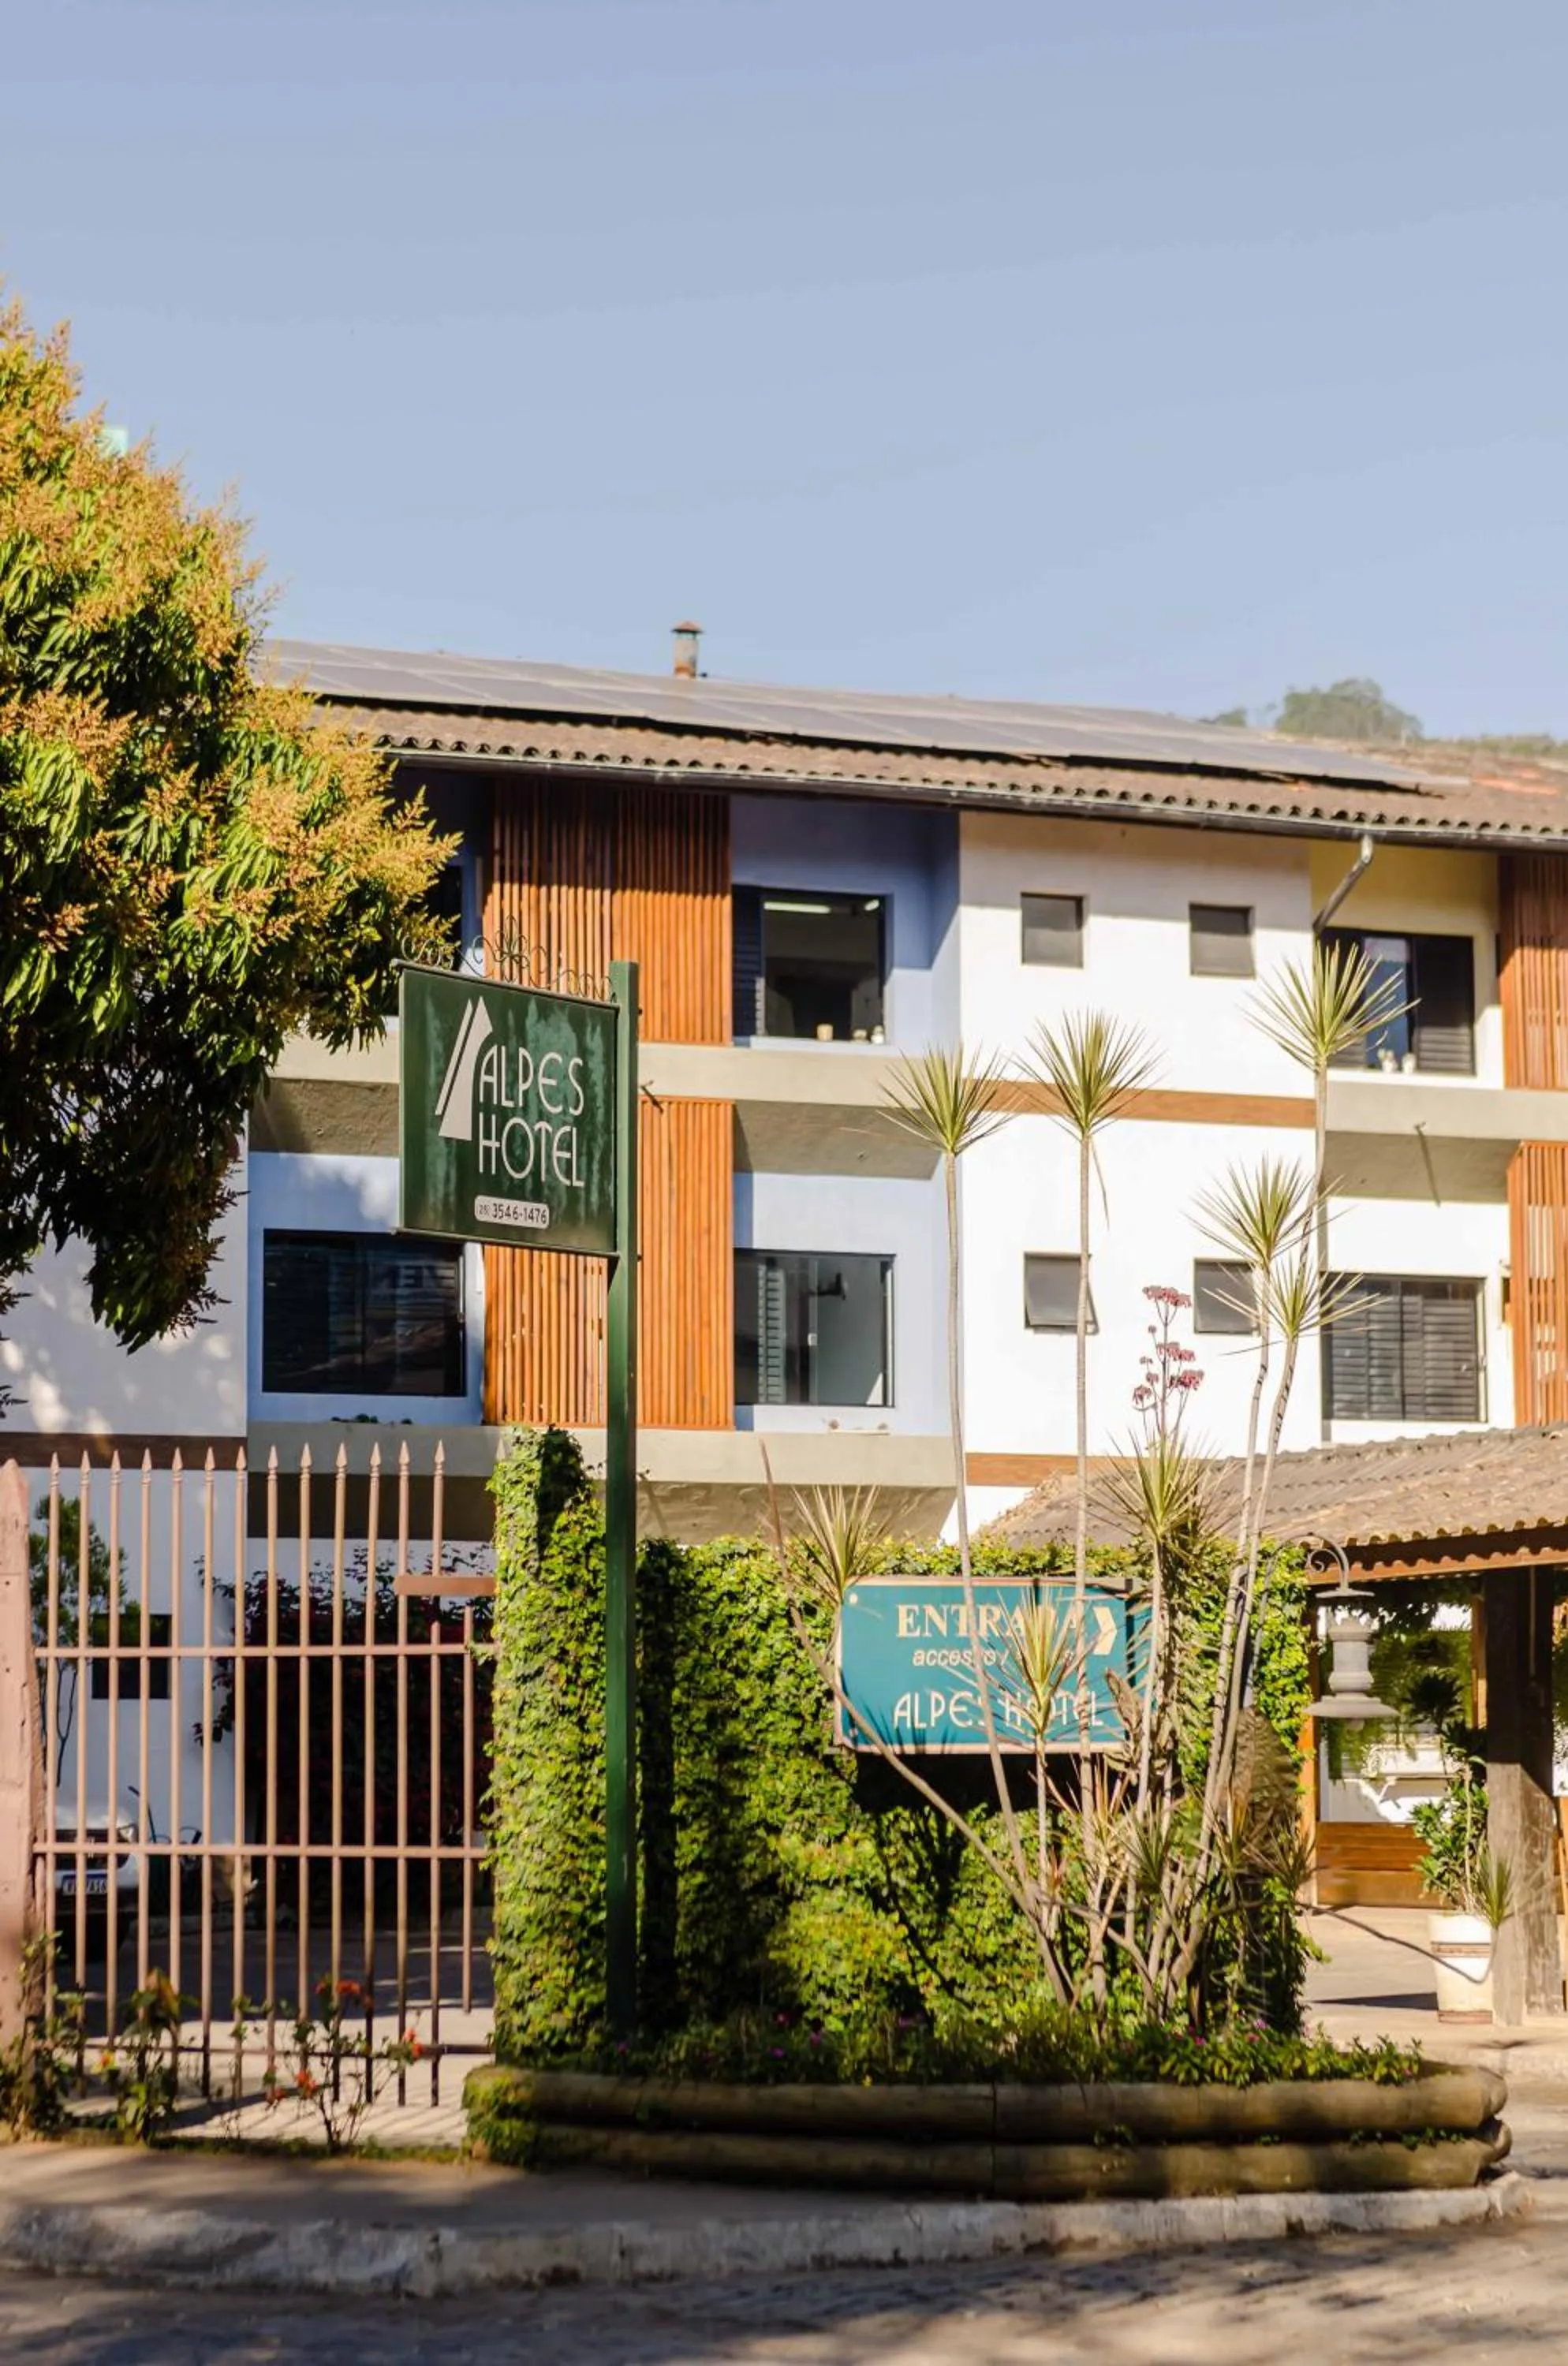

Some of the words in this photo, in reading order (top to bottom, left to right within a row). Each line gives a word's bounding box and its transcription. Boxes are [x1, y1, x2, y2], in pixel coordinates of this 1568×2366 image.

[480, 1043, 584, 1117] ALPES
[479, 1111, 584, 1188] HOTEL
[492, 1203, 547, 1224] 3546-1476
[896, 1603, 1087, 1638] ENTRA
[913, 1648, 996, 1667] acceso
